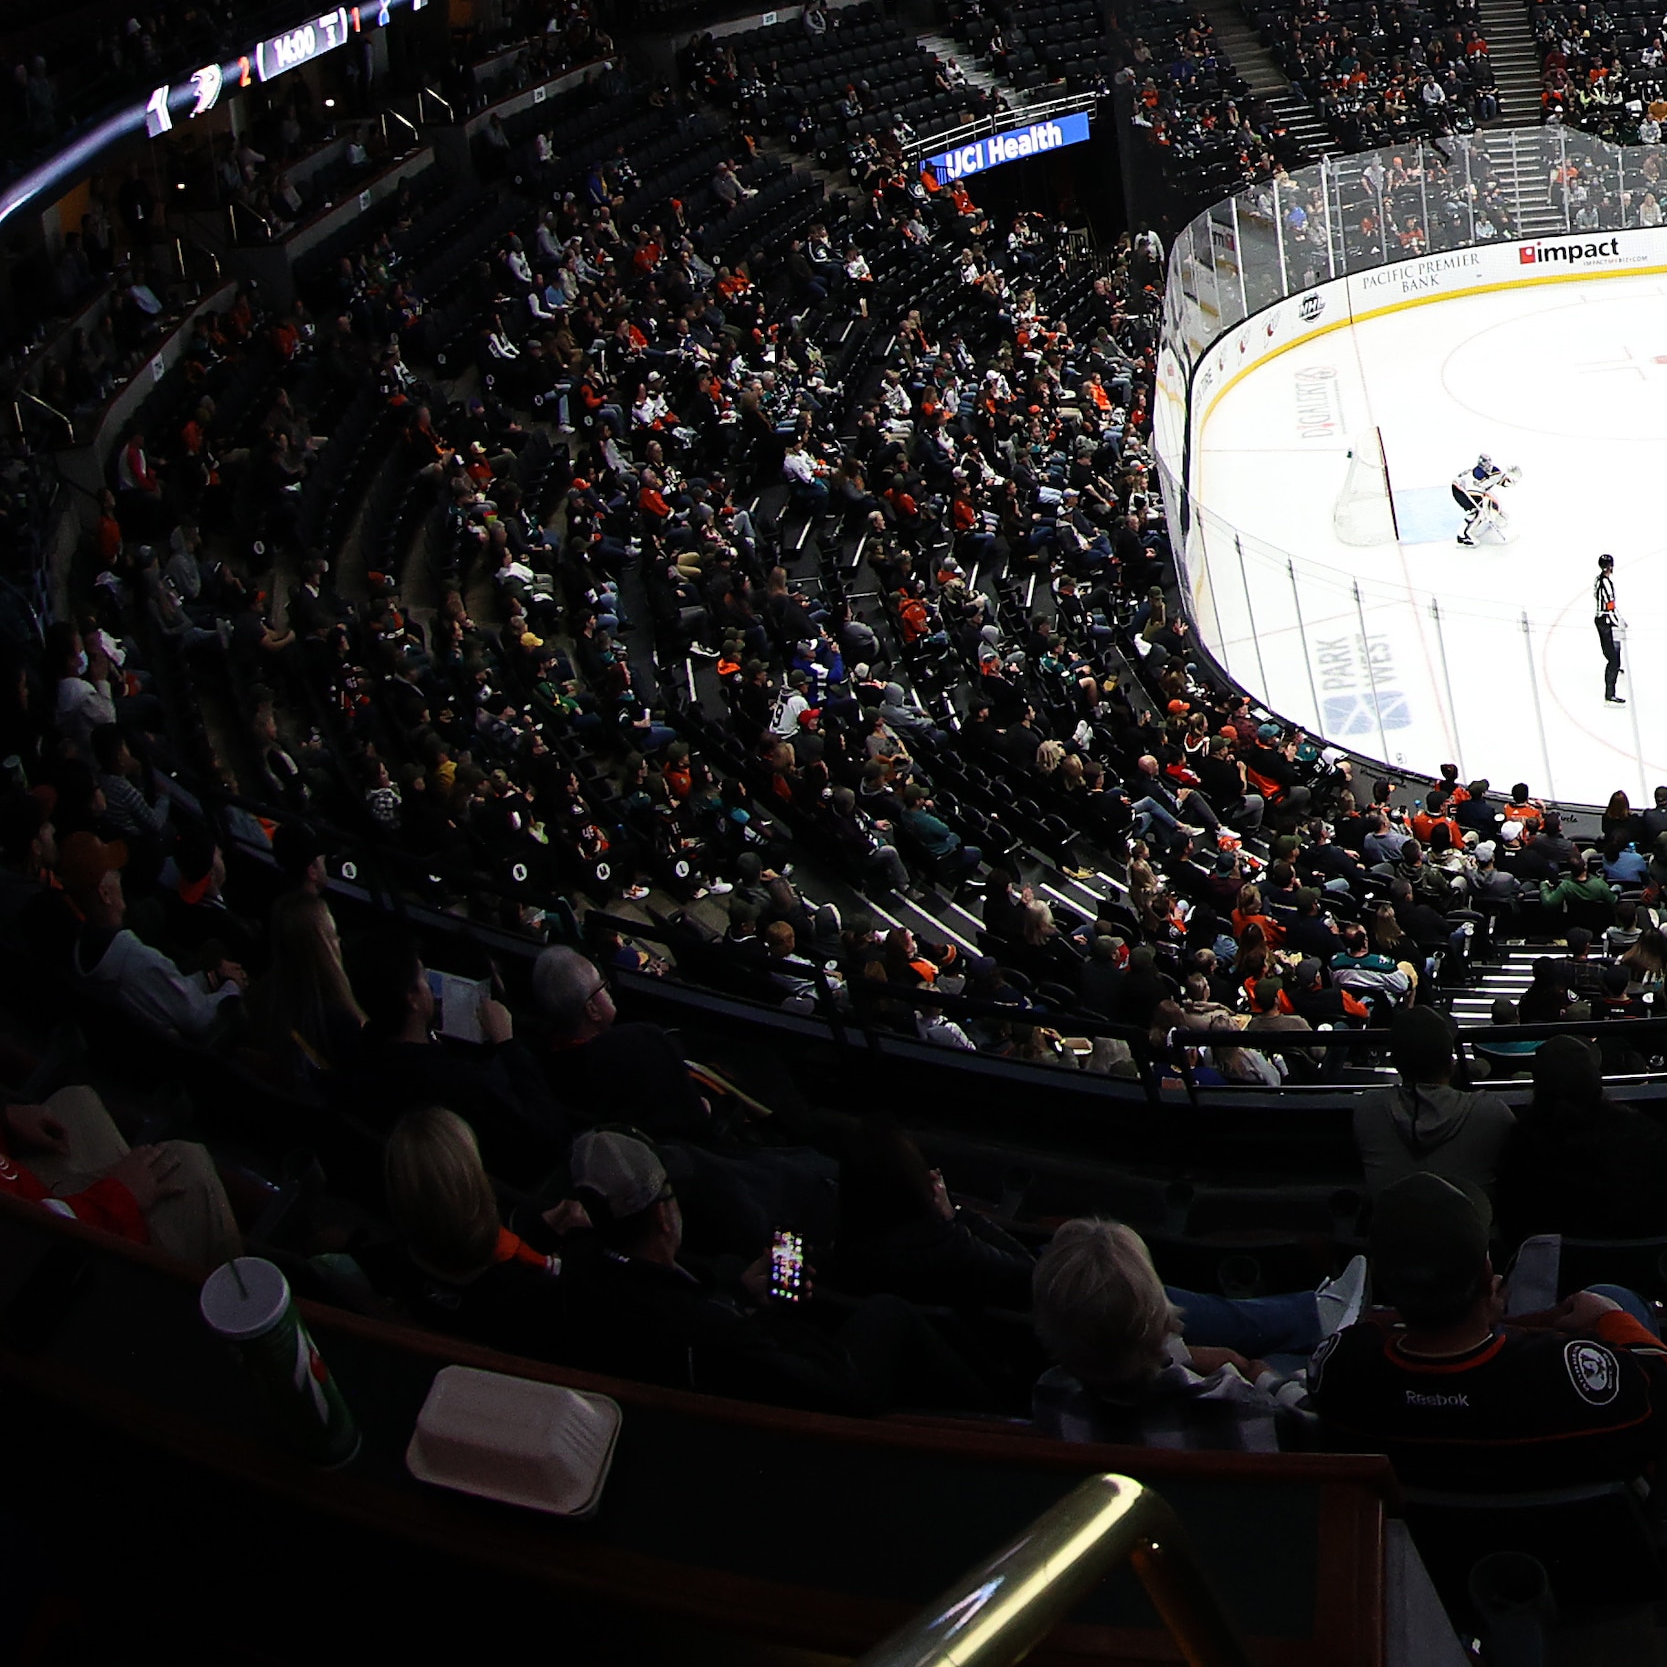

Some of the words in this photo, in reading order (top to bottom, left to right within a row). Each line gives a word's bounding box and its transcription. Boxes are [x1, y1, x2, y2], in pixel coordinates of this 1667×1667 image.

[238, 56, 251, 87] 2
[274, 26, 315, 66] 14:00
[326, 26, 336, 47] 3
[350, 8, 361, 32] 1
[945, 144, 984, 178] UCI
[988, 122, 1062, 164] Health
[1537, 238, 1619, 265] impact
[1363, 266, 1416, 289] PACIFIC
[1418, 253, 1480, 275] PREMIER
[1402, 274, 1440, 293] BANK
[1299, 295, 1326, 315] NHL
[1316, 636, 1357, 690] PARK
[1355, 633, 1397, 687] WEST
[1405, 1389, 1470, 1408] Reebok
